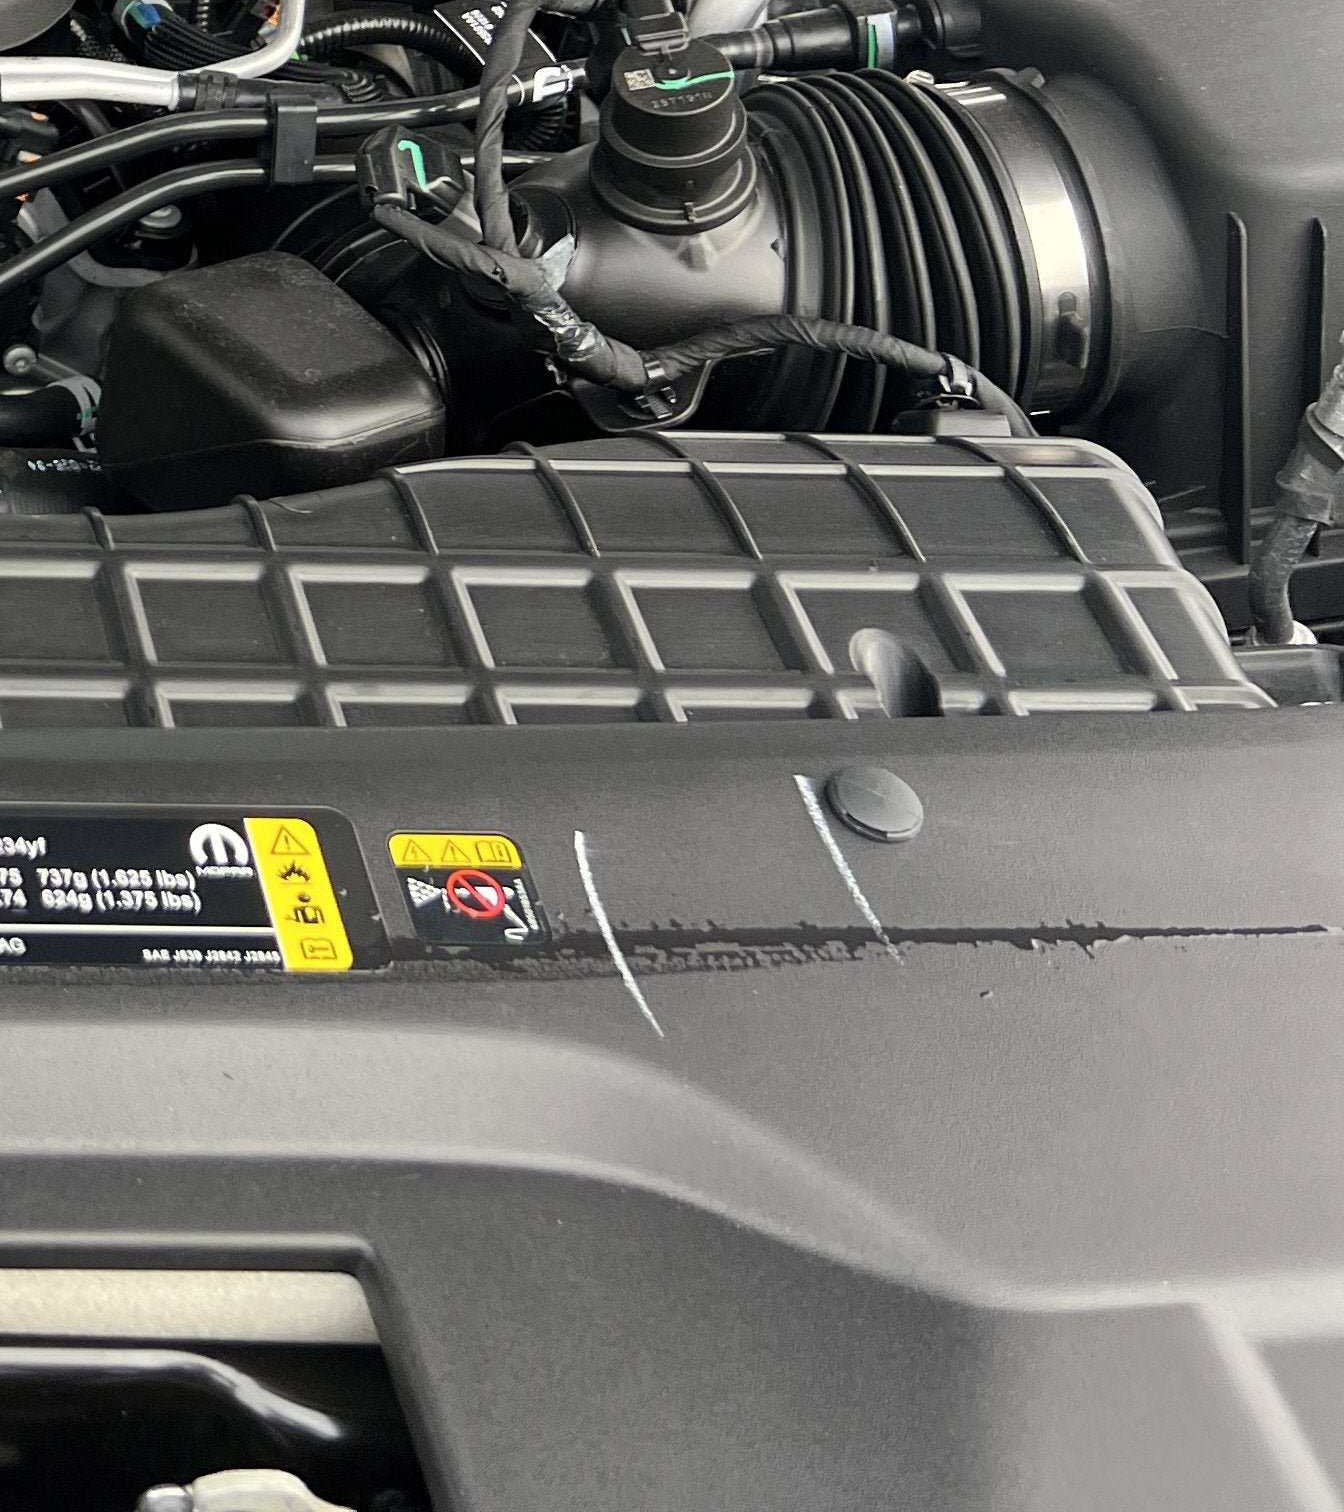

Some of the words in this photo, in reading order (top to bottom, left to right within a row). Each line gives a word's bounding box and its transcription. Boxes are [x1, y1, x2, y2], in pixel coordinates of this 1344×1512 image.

[36, 868, 89, 891] 737g
[156, 870, 196, 891] lbs)
[41, 889, 93, 913] 624g
[161, 891, 202, 915] lbs)
